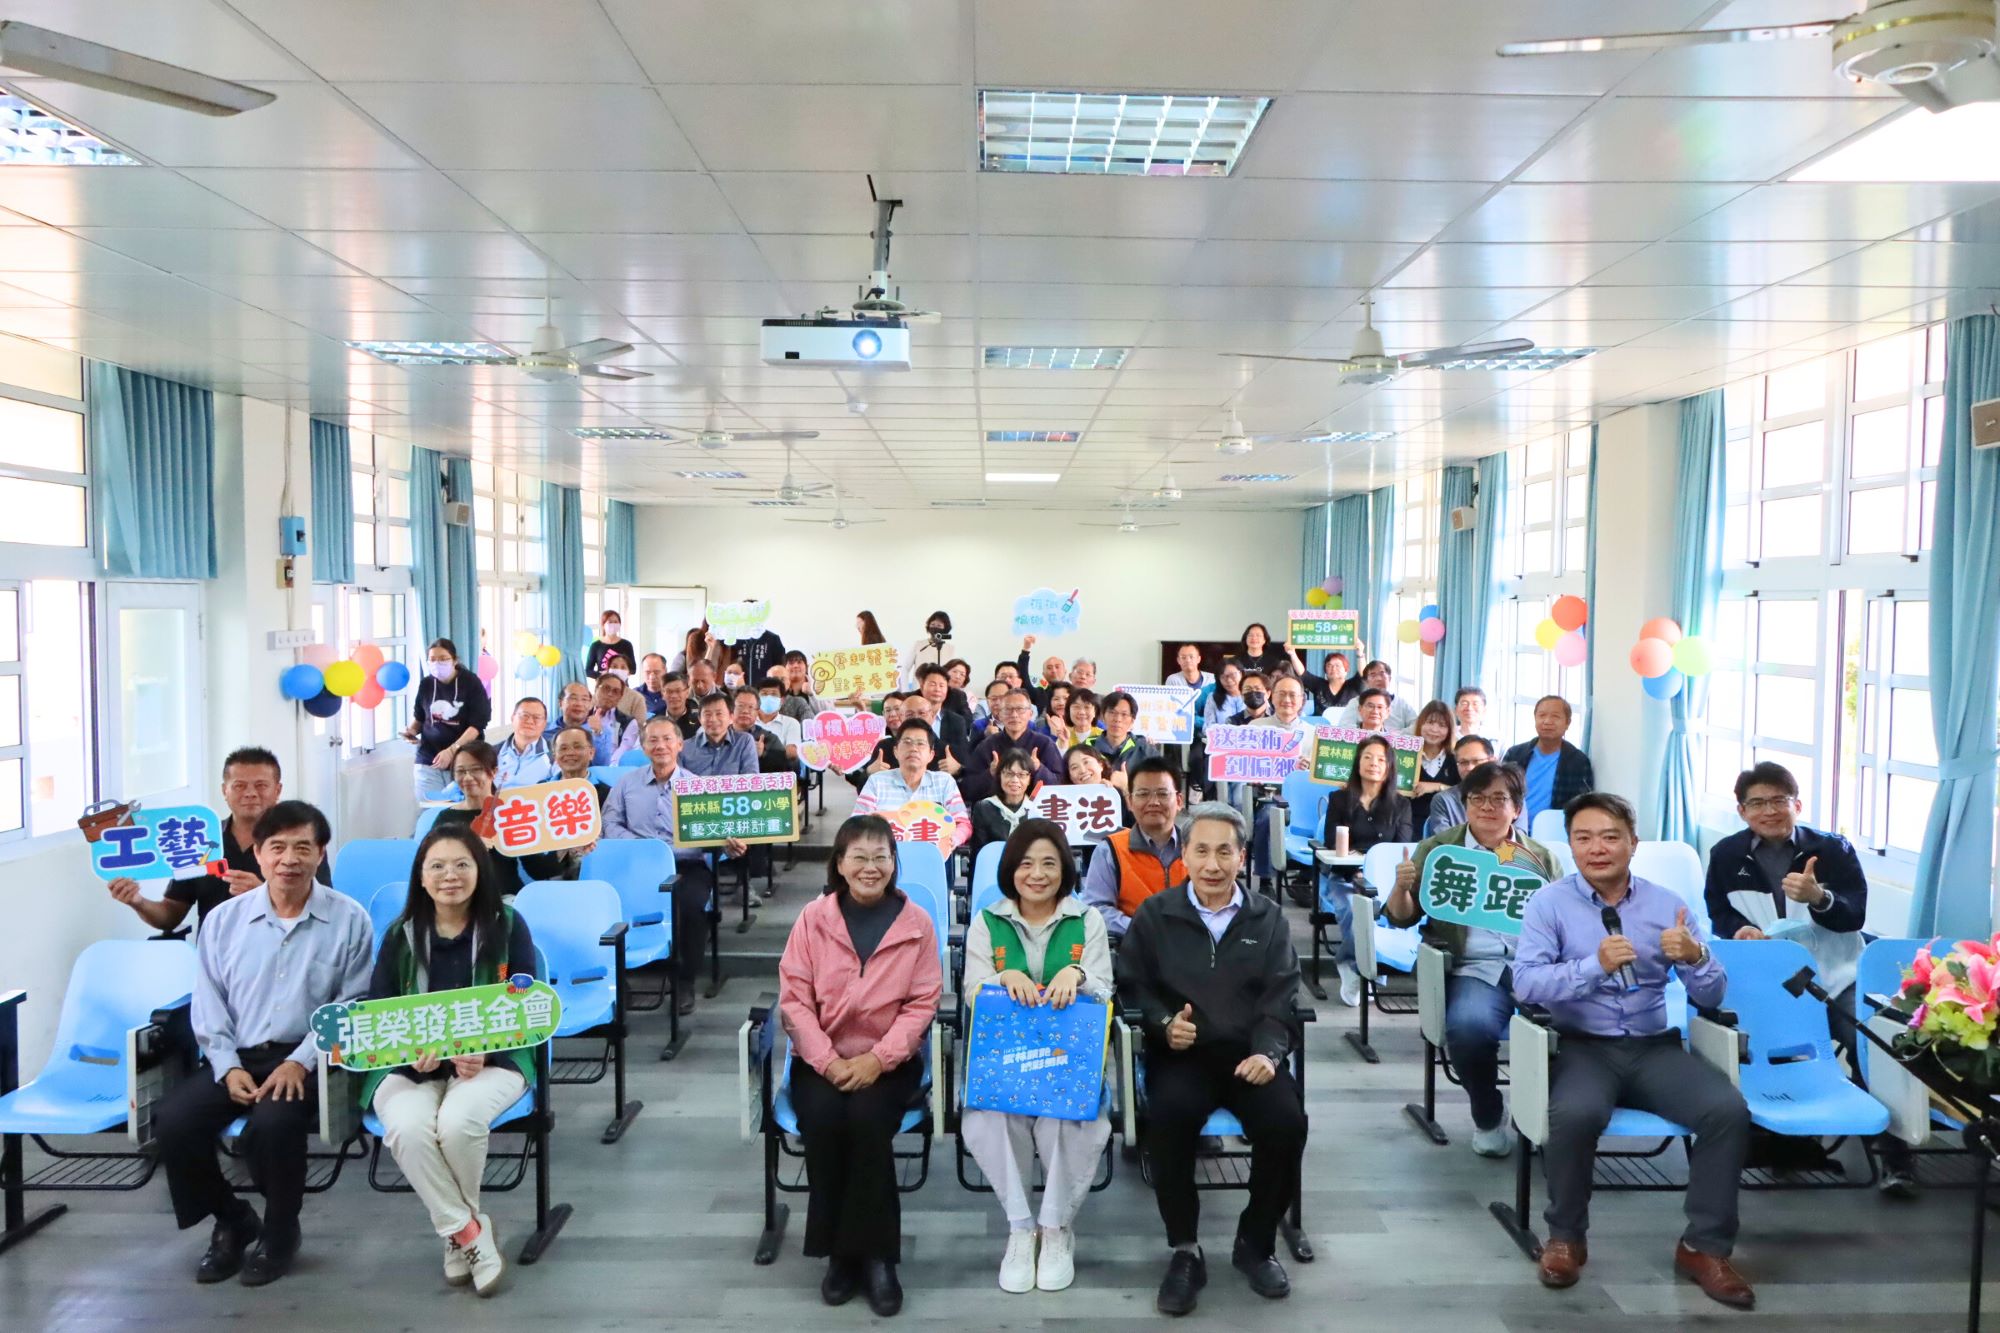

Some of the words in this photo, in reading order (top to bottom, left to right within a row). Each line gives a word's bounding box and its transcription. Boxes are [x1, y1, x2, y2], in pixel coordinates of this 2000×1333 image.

[1214, 728, 1282, 750] 送藝術
[675, 774, 794, 793] 張榮發基金會支持
[1231, 756, 1295, 777] 到偏鄉
[498, 791, 592, 846] 音樂
[690, 818, 781, 836] 藝文深耕計畫
[1037, 794, 1115, 832] 書法
[100, 816, 209, 869] 工藝
[1429, 855, 1542, 920] 舞蹈
[337, 989, 555, 1055] 張榮發基金會
